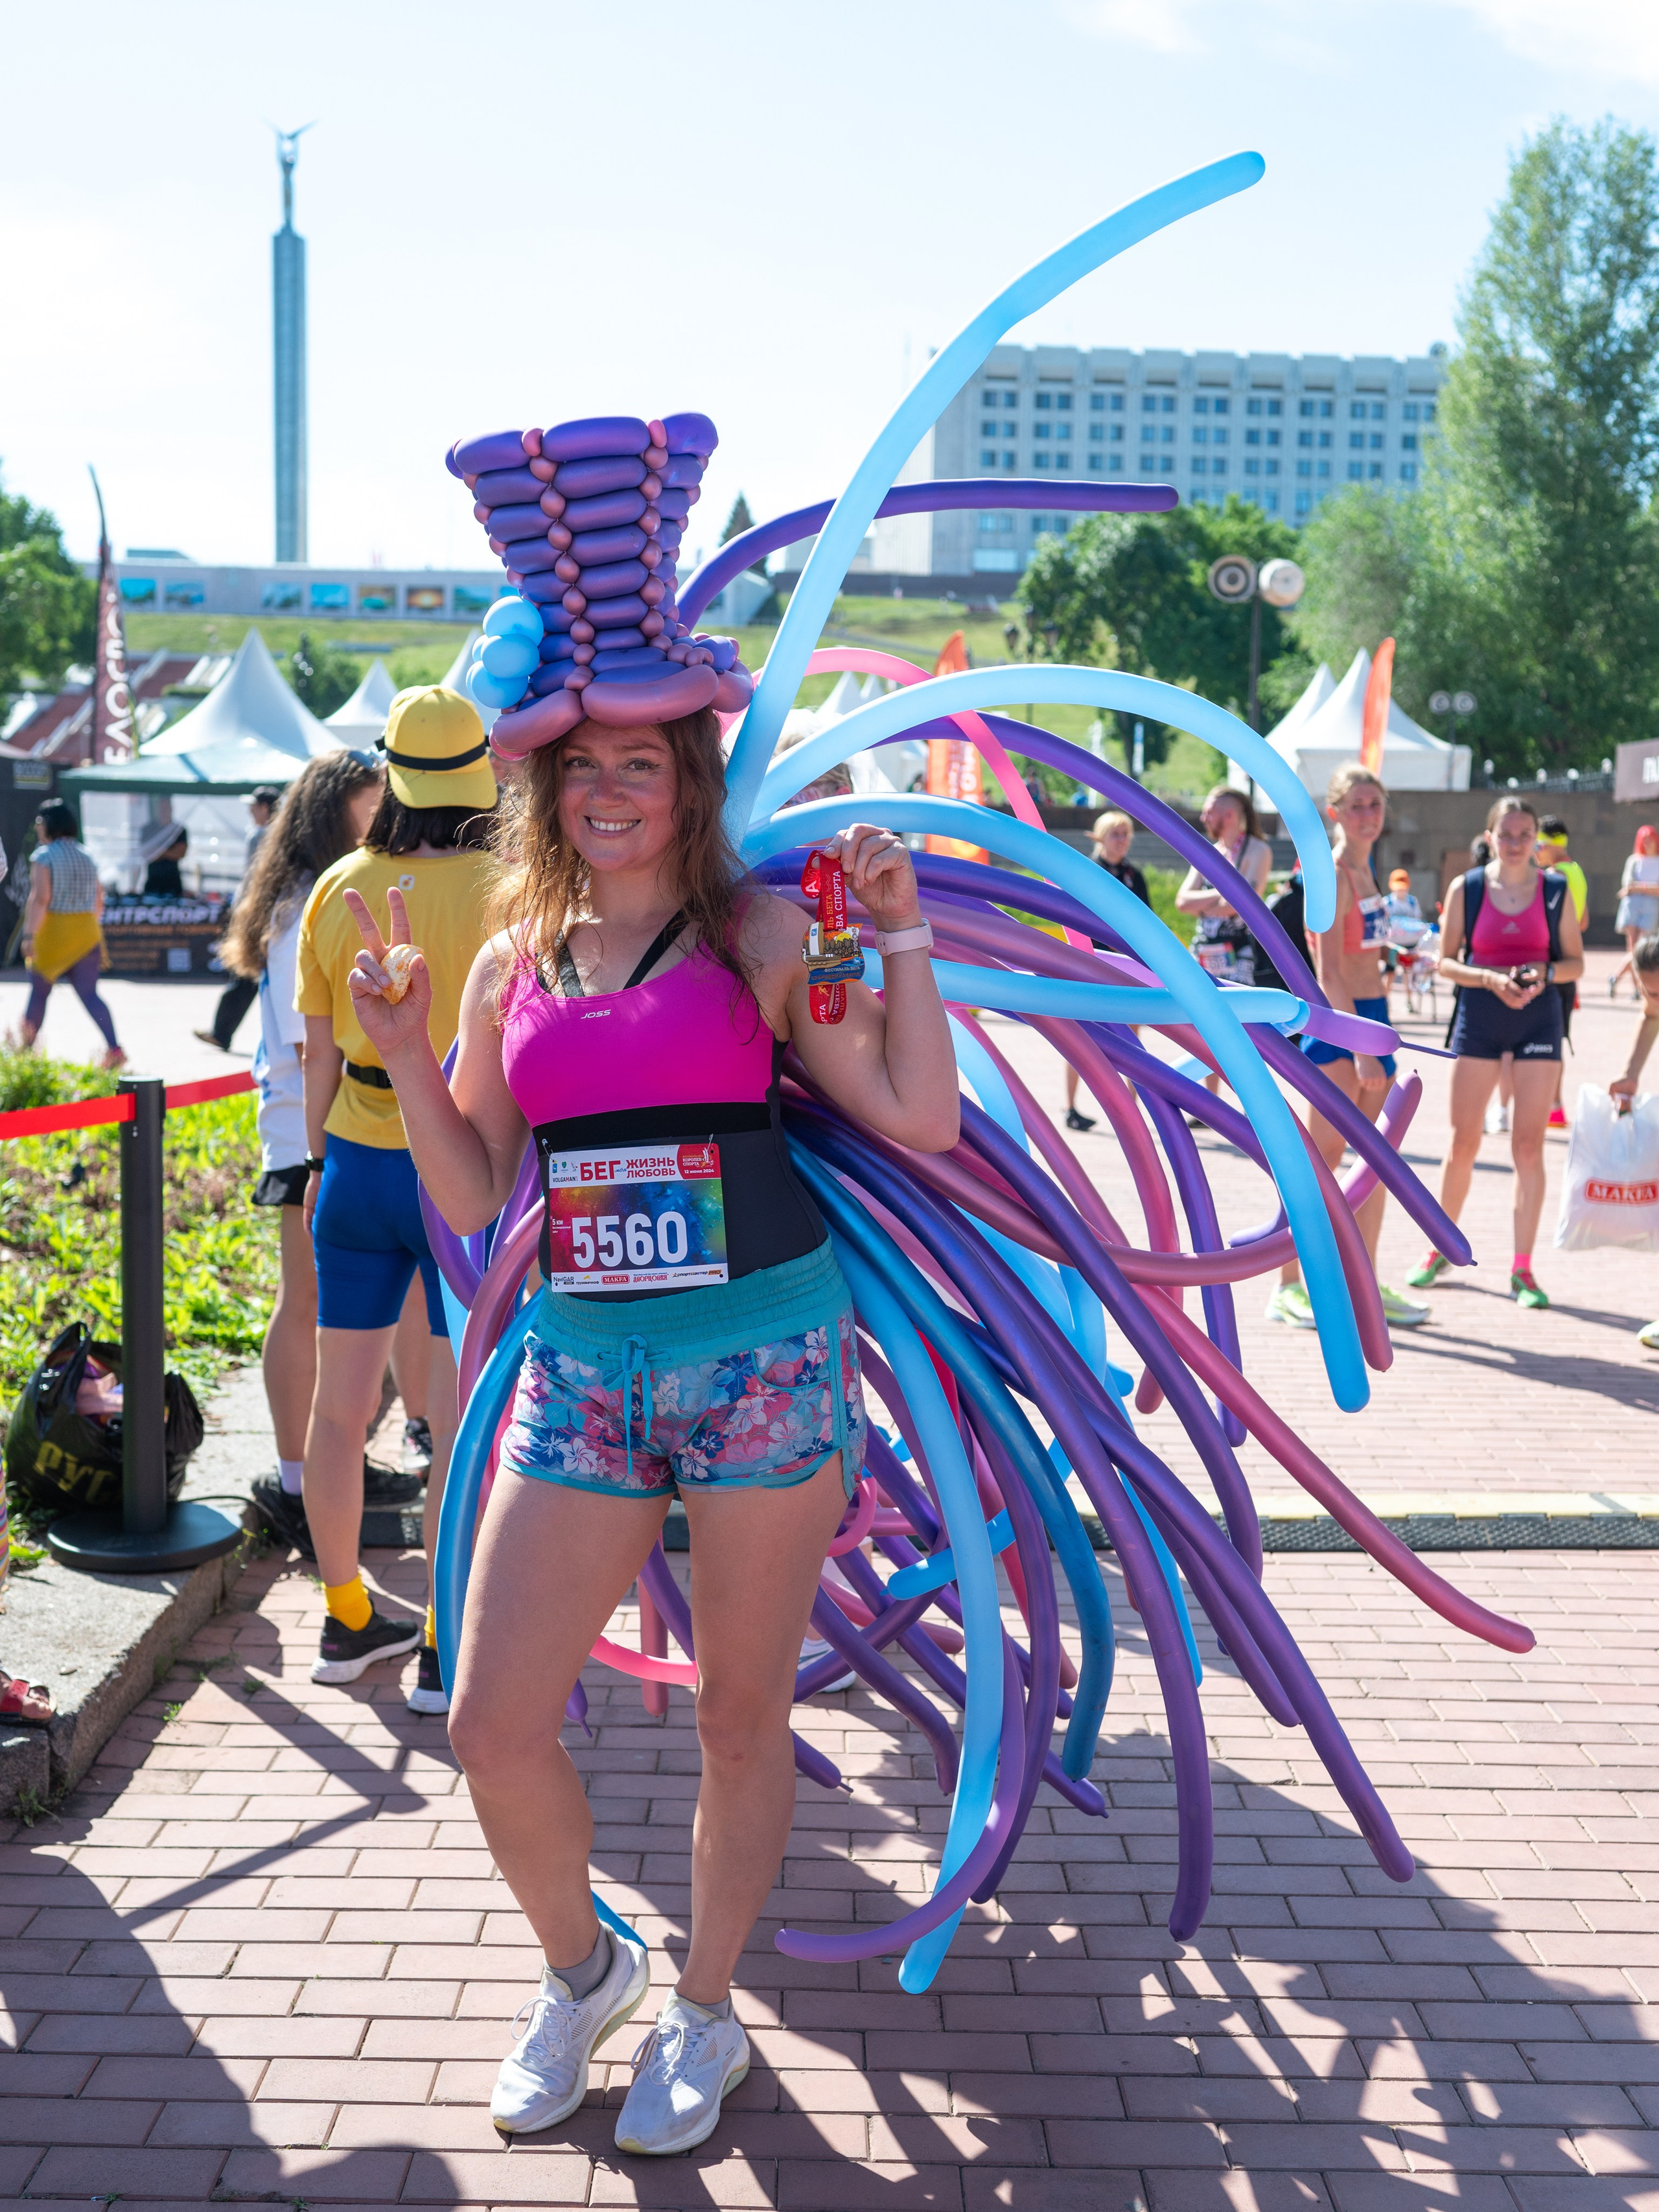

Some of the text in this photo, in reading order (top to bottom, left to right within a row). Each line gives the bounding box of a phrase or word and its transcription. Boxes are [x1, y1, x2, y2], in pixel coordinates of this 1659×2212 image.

[833, 870, 844, 911] СПОРТА
[581, 1009, 611, 1019] JOSS
[580, 1160, 621, 1182] БЕГ
[626, 1158, 675, 1169] ЖИЗНЬ
[627, 1168, 676, 1178] ЛЮБОВЬ
[1592, 1183, 1654, 1202] MAKFA
[572, 1211, 688, 1268] 5560
